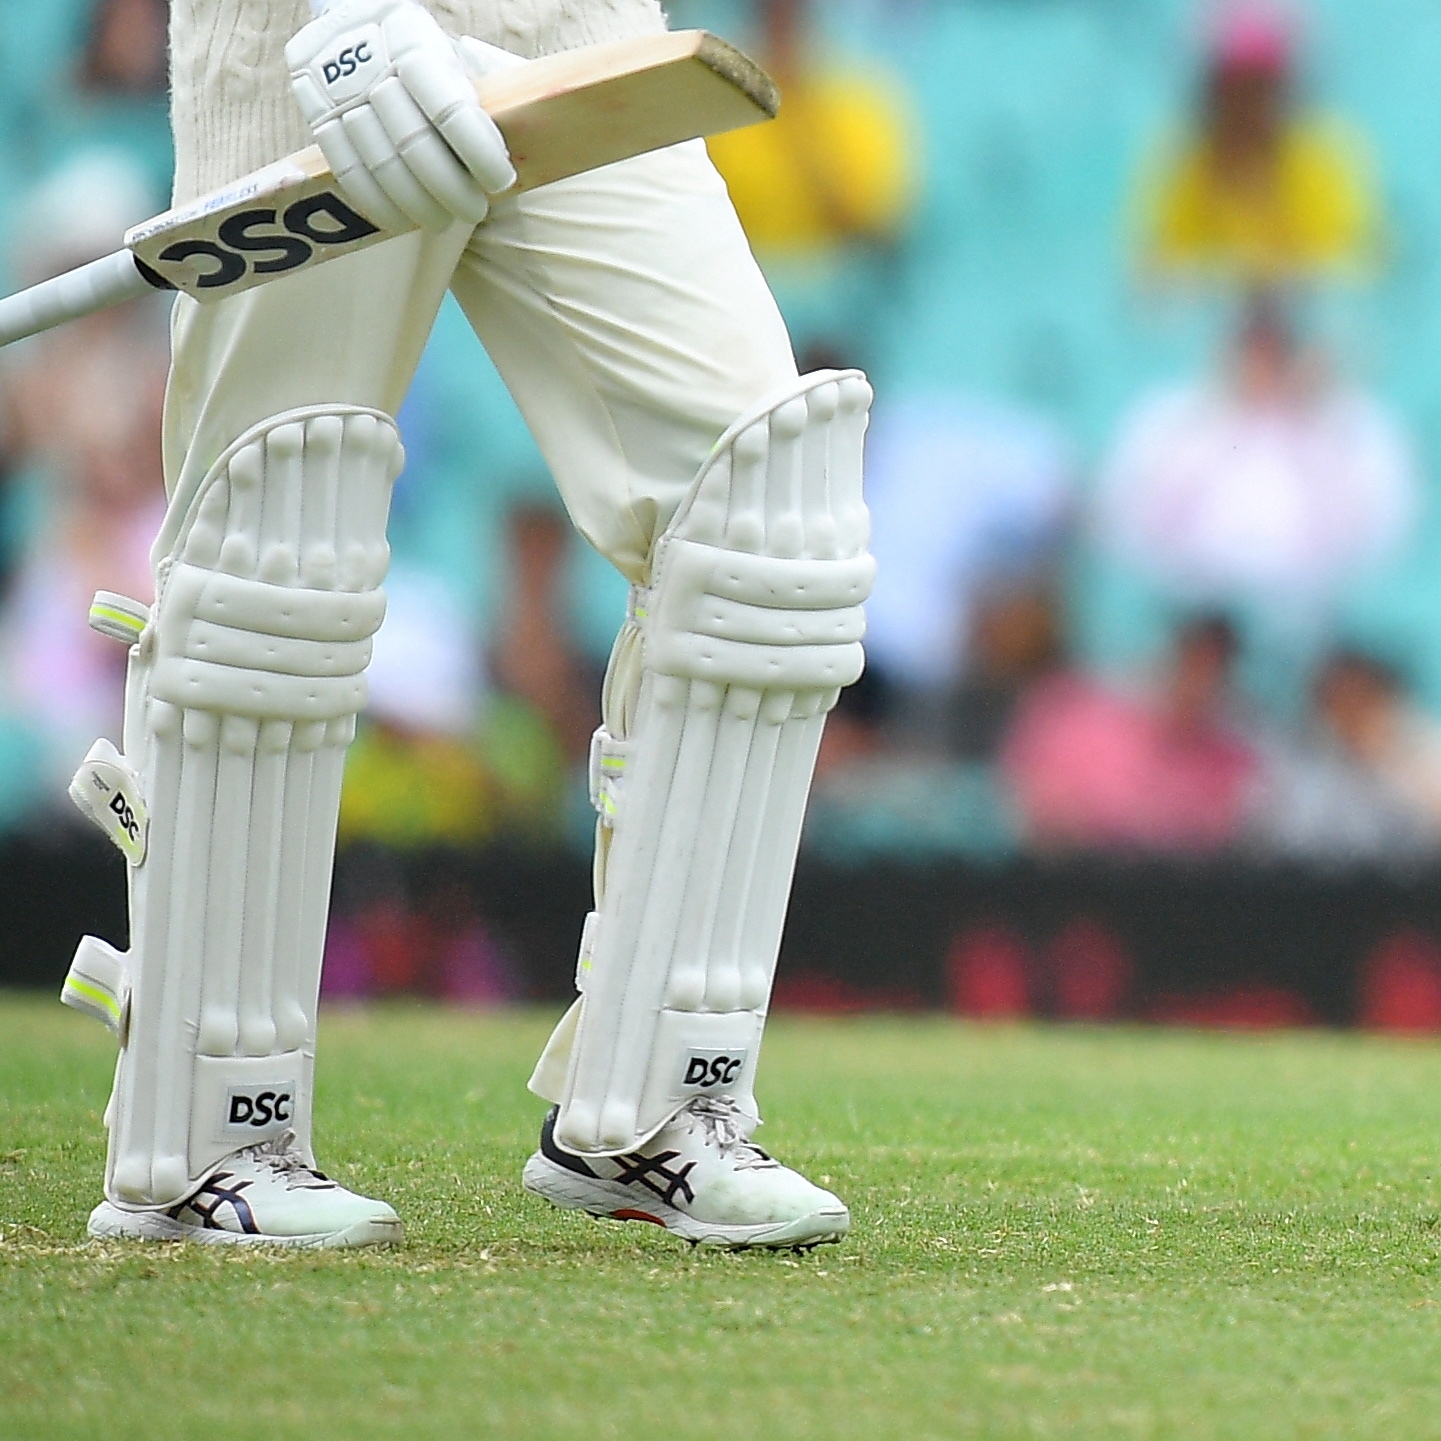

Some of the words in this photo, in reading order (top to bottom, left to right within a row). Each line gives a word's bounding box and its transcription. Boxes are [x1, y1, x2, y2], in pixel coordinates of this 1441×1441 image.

[323, 41, 372, 85] DSC
[158, 191, 381, 288] DSC
[109, 791, 139, 842] DSC
[683, 1056, 742, 1087] DSC
[229, 1091, 290, 1127] DSC
